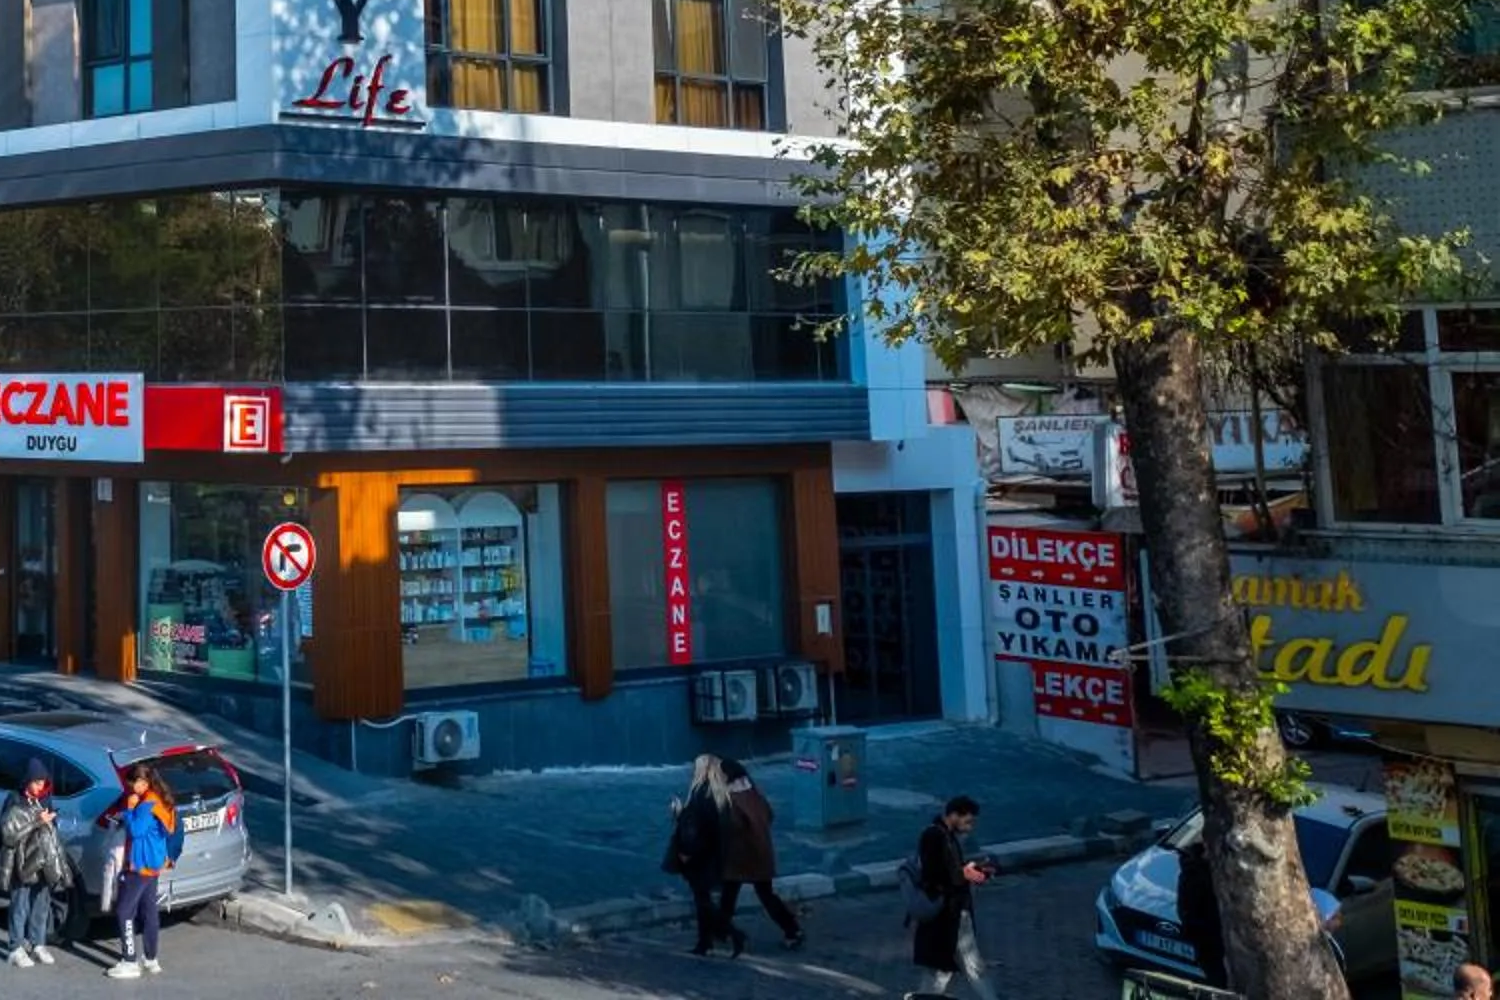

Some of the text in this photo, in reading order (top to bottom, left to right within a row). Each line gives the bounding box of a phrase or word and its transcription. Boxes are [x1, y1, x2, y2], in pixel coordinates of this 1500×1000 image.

[292, 54, 410, 126] Life
[239, 407, 257, 441] E
[27, 435, 77, 452] DUYGU
[991, 532, 1115, 571] DİLEKÇE
[666, 492, 687, 653] ECZANE
[1015, 607, 1099, 637] OTO
[998, 631, 1122, 664] YIKAMA
[1251, 615, 1432, 692] tadı
